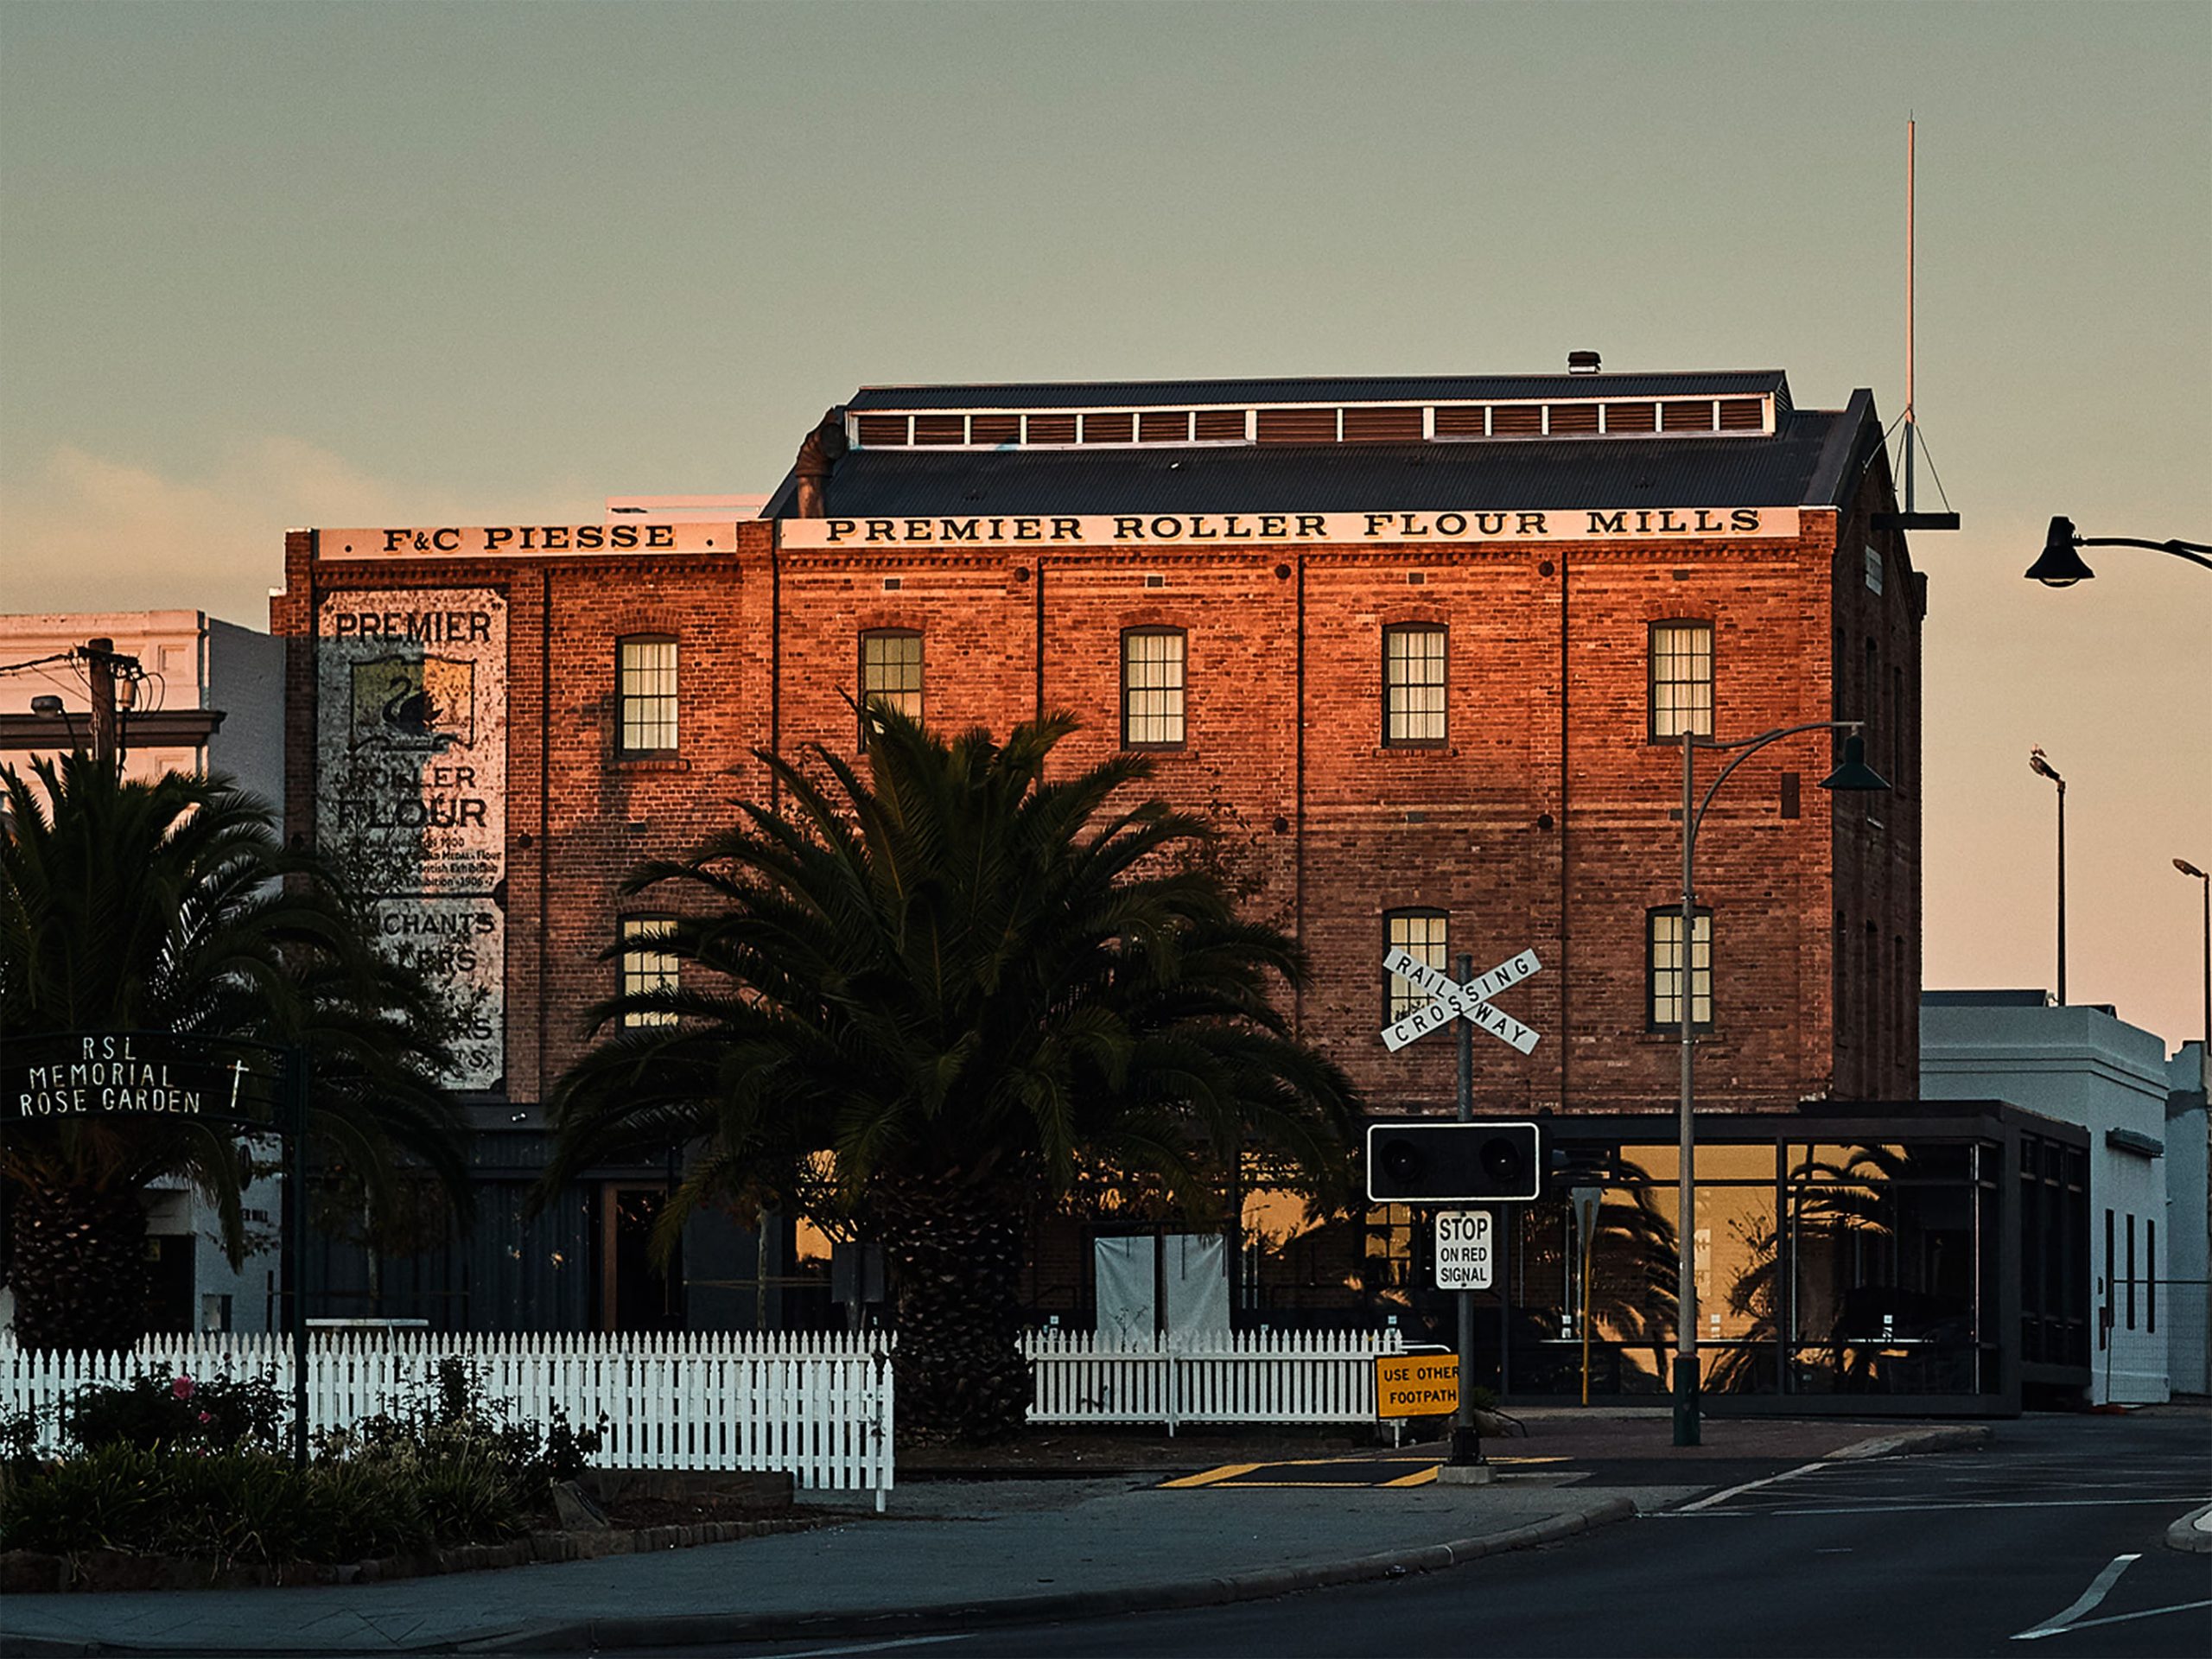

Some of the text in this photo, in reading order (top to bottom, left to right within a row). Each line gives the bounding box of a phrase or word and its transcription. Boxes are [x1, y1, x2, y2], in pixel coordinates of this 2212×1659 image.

[383, 525, 676, 552] F&C PIESSE
[826, 509, 1760, 542] PREMIER ROLLER FLOUR MILLS
[335, 612, 492, 643] PREMIER
[338, 798, 487, 828] FLOUR
[1395, 957, 1529, 1042] CROSSING
[29, 1063, 175, 1090] MEMORIAL
[20, 1088, 200, 1116] ROSE GARDEN
[1440, 1218, 1488, 1241] STOP
[1440, 1248, 1487, 1262] ON RED
[1440, 1268, 1487, 1281] SIGNAL
[1384, 1366, 1459, 1382] USE OTHER
[1389, 1389, 1457, 1404] FOOTPATH
